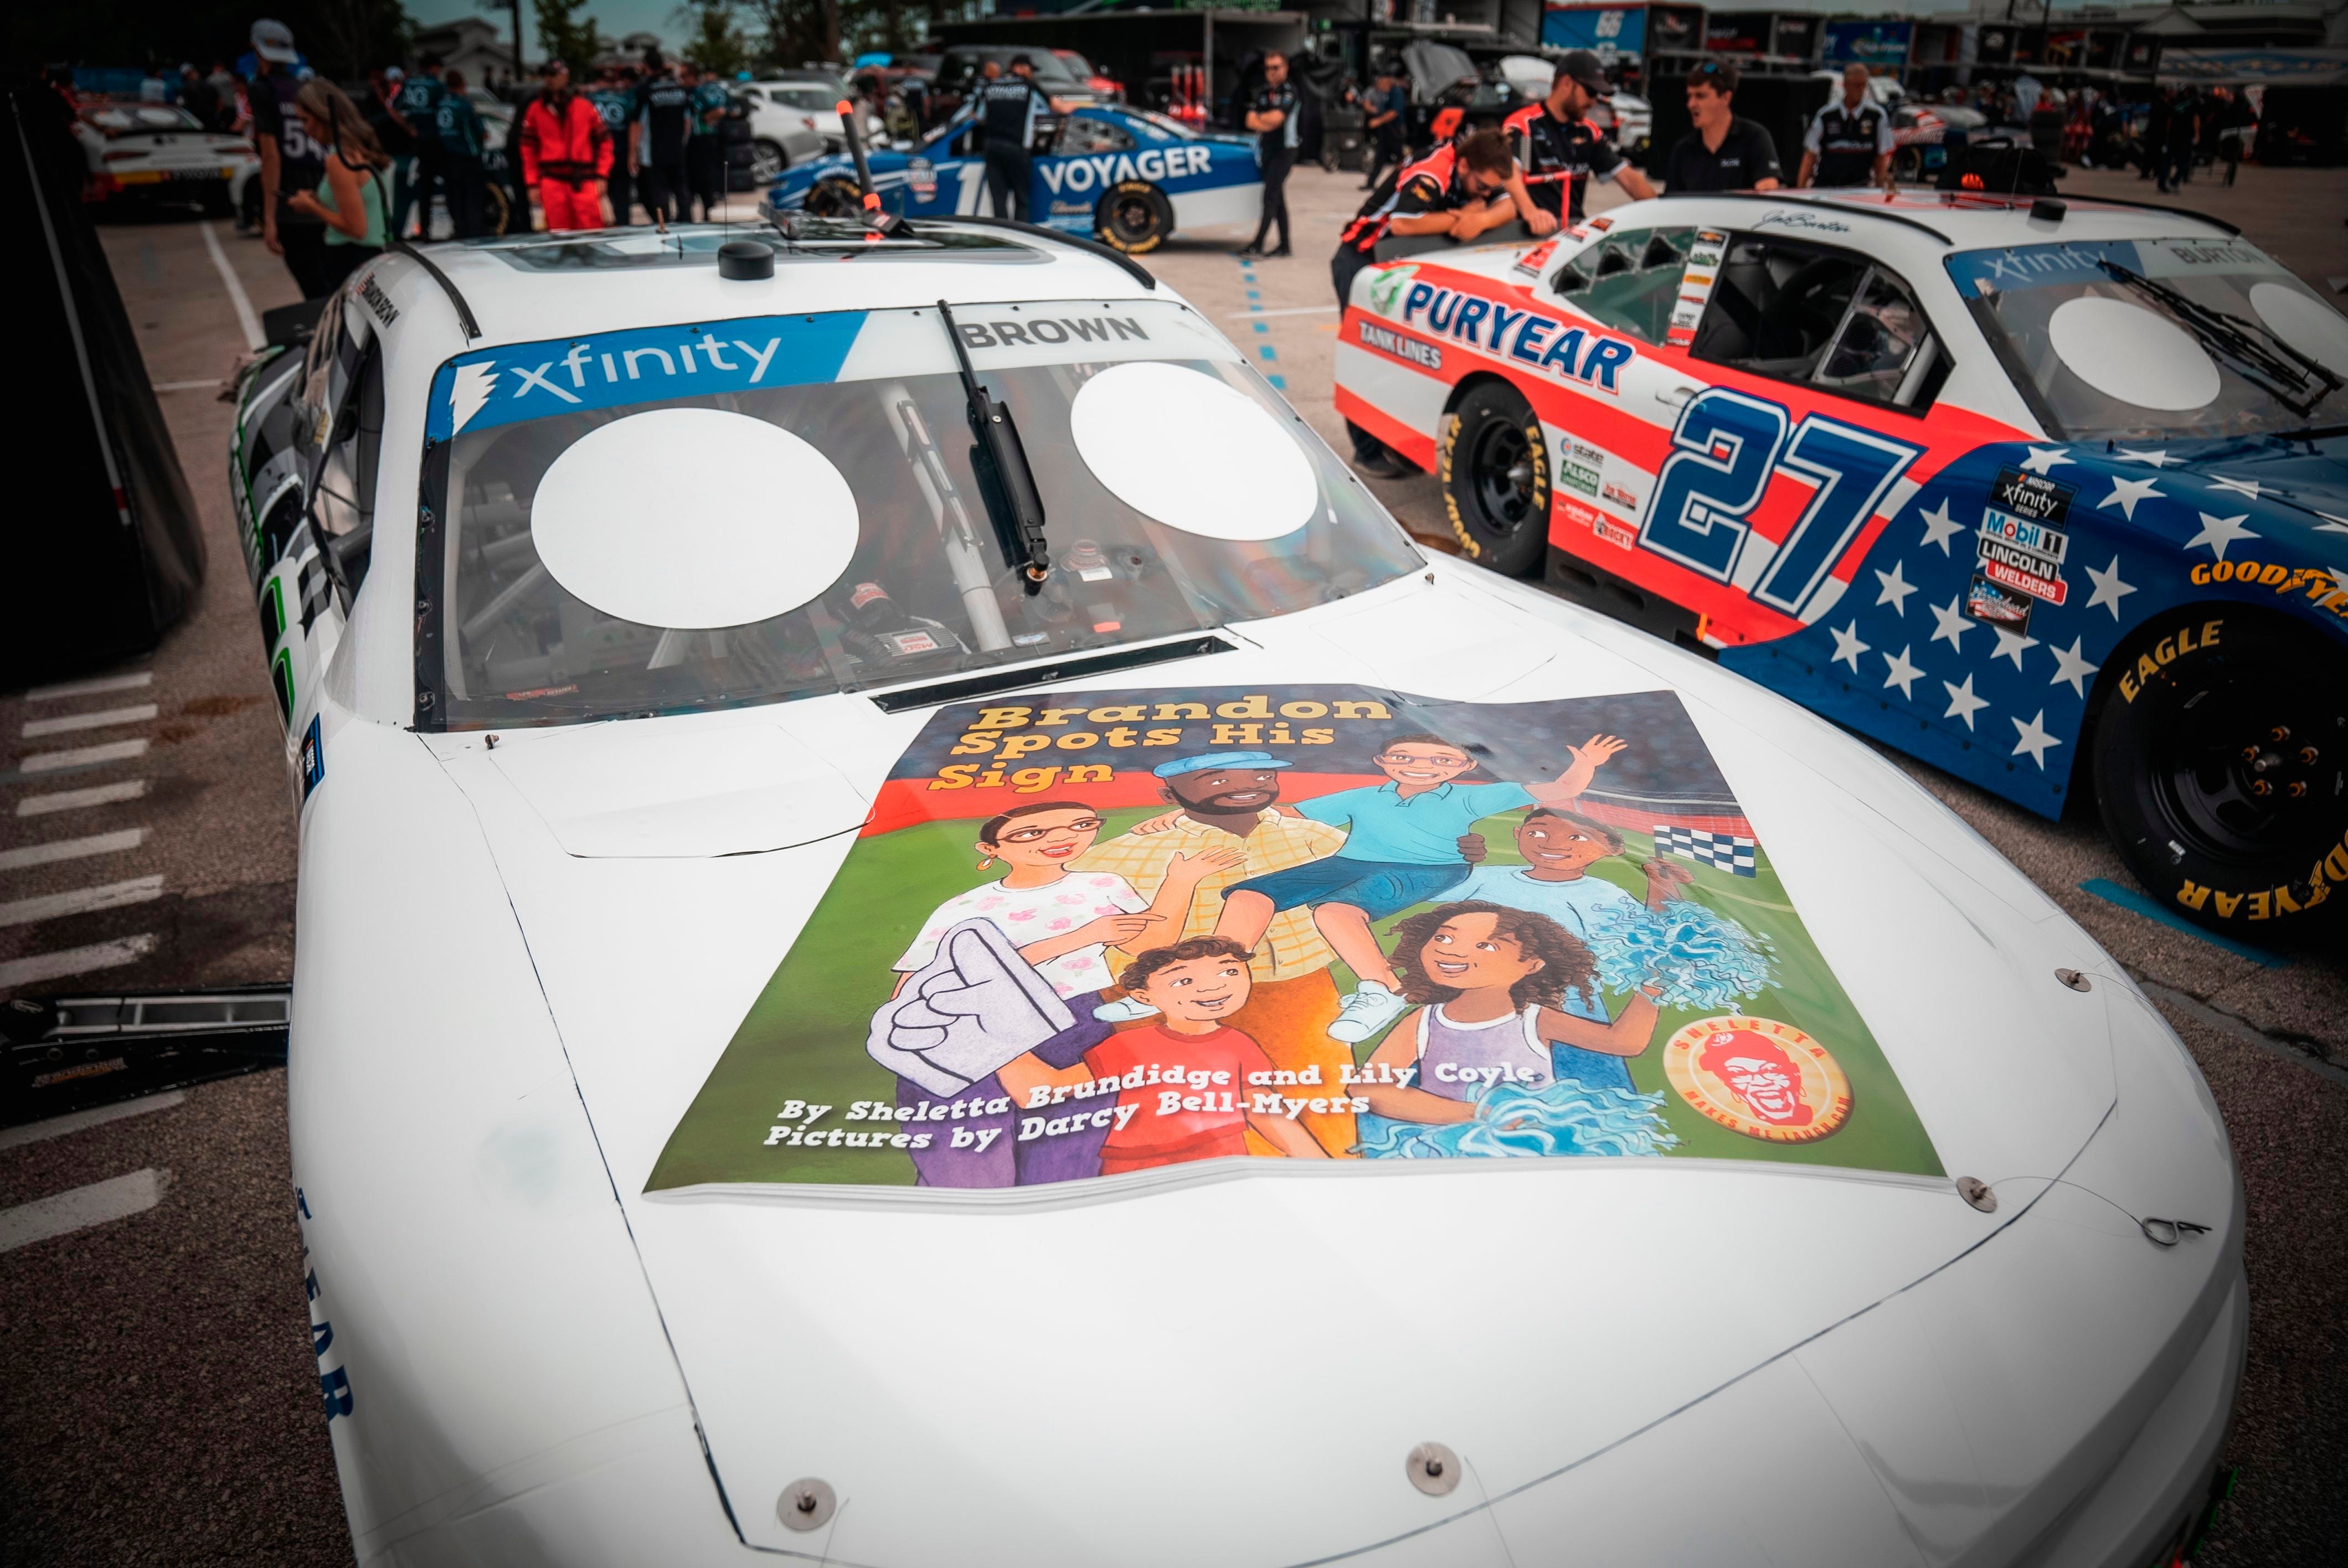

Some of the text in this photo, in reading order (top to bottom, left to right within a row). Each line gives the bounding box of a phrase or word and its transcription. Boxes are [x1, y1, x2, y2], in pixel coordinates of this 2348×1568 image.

[1039, 145, 1213, 194] VOYAGER
[1984, 245, 2107, 283] xfinity
[2171, 247, 2266, 265] BURTON
[956, 317, 1151, 349] BROWN
[1359, 321, 1441, 370] TANK LINES
[1403, 280, 1636, 395] PURYEAR
[510, 333, 781, 404] xfinity
[1525, 425, 1547, 510] EAGLE
[2026, 475, 2056, 492] NASCAR
[1636, 385, 1929, 620] 27
[2002, 483, 2059, 517] xfinity
[2014, 503, 2039, 518] SERIES
[1987, 510, 2040, 546] Mobil
[1982, 540, 2053, 580] LINCOLN
[1995, 564, 2057, 599] WELDERS
[2191, 560, 2348, 618] GOODYE
[2118, 619, 2224, 704] EAGLE
[967, 694, 1392, 731] Brandon
[950, 721, 1335, 760] Spots His
[928, 760, 1114, 794] Sign
[1673, 1019, 1826, 1059] SHELETTA
[777, 1061, 1536, 1125] By Sheletta Brundidge and Lily Coyle
[763, 1091, 1369, 1153] Pictures by Darcy Bell-Myers
[1683, 1090, 1851, 1141] MAKES ME LAUGH.COM
